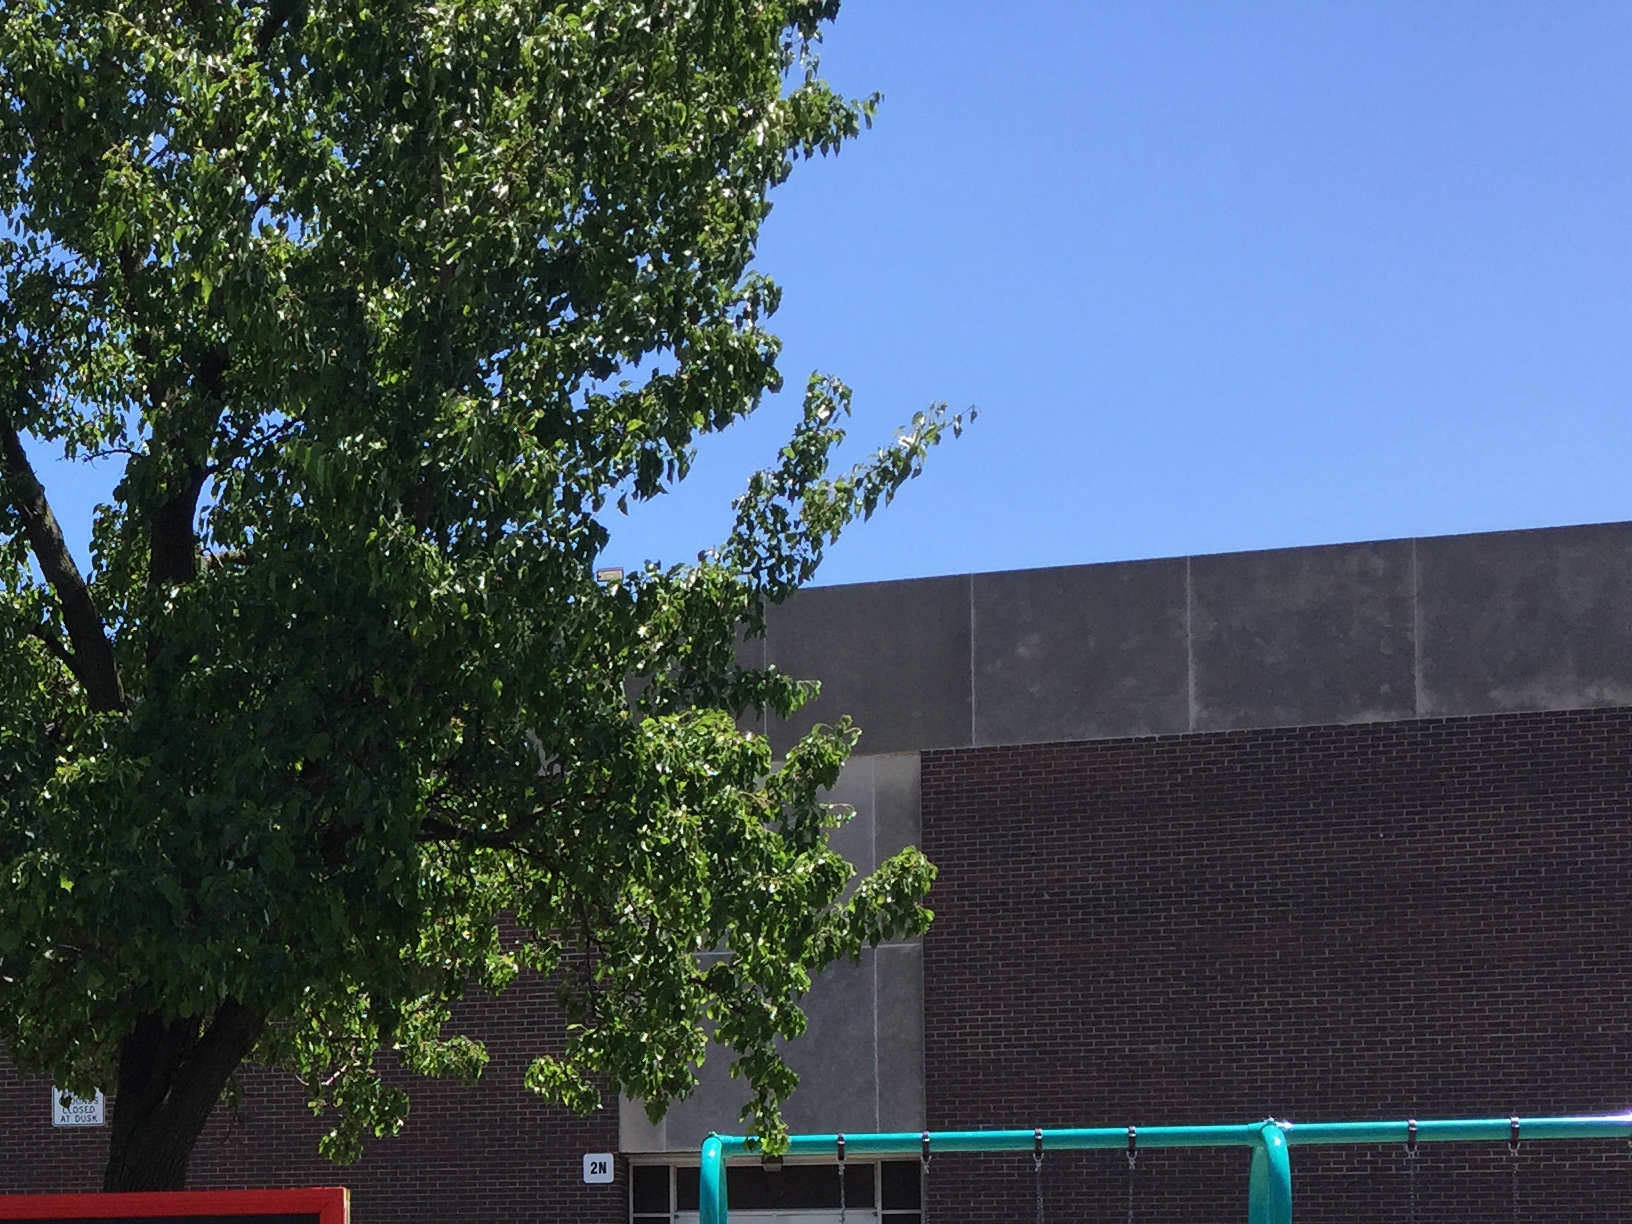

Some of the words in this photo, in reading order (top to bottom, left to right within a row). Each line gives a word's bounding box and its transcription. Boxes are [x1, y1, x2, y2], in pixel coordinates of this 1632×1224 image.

[62, 1105, 95, 1114] CLOSED
[74, 1114, 98, 1122] DUSK
[590, 1161, 607, 1174] 2N
